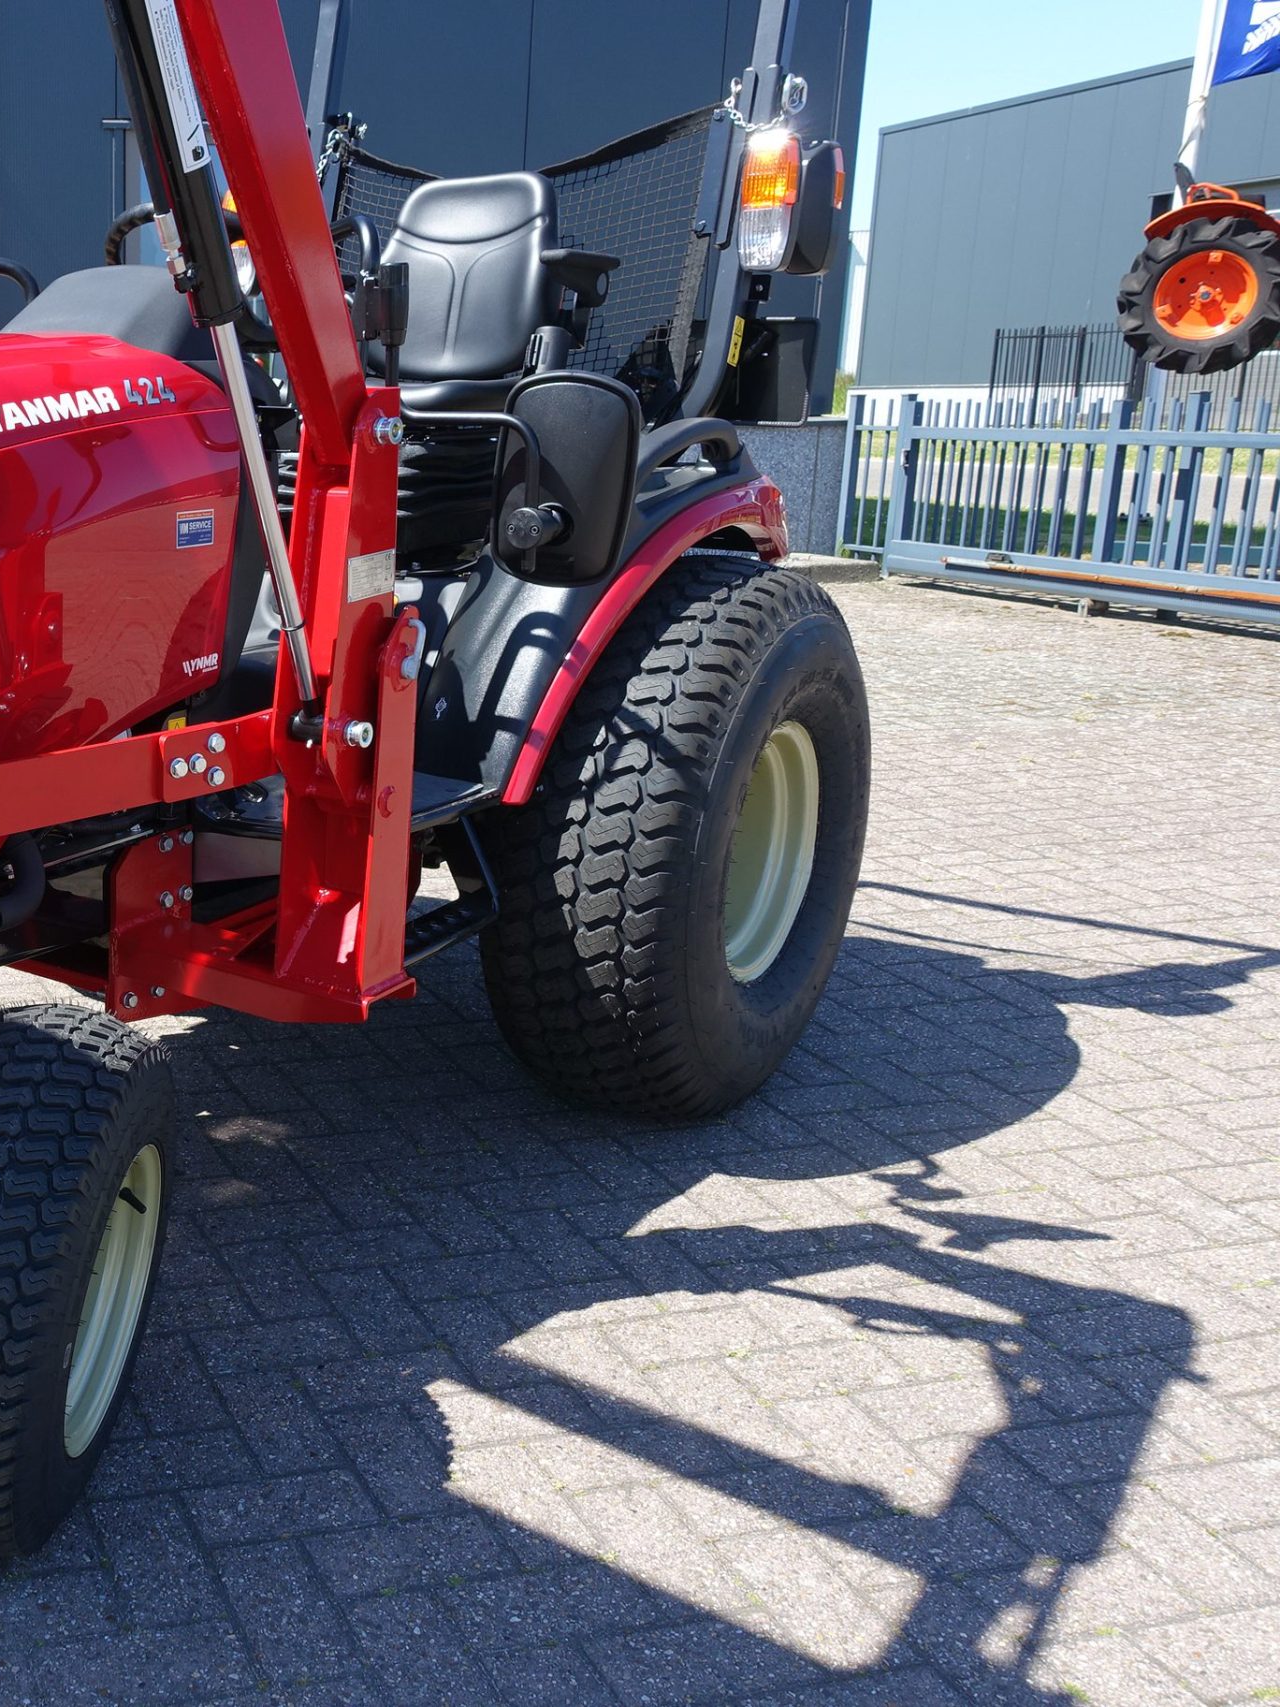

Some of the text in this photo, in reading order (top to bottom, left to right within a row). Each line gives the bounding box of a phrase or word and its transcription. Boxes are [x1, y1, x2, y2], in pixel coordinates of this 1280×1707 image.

[123, 376, 176, 406] 424
[188, 520, 212, 530] SERVICE
[190, 652, 219, 671] YNMR
